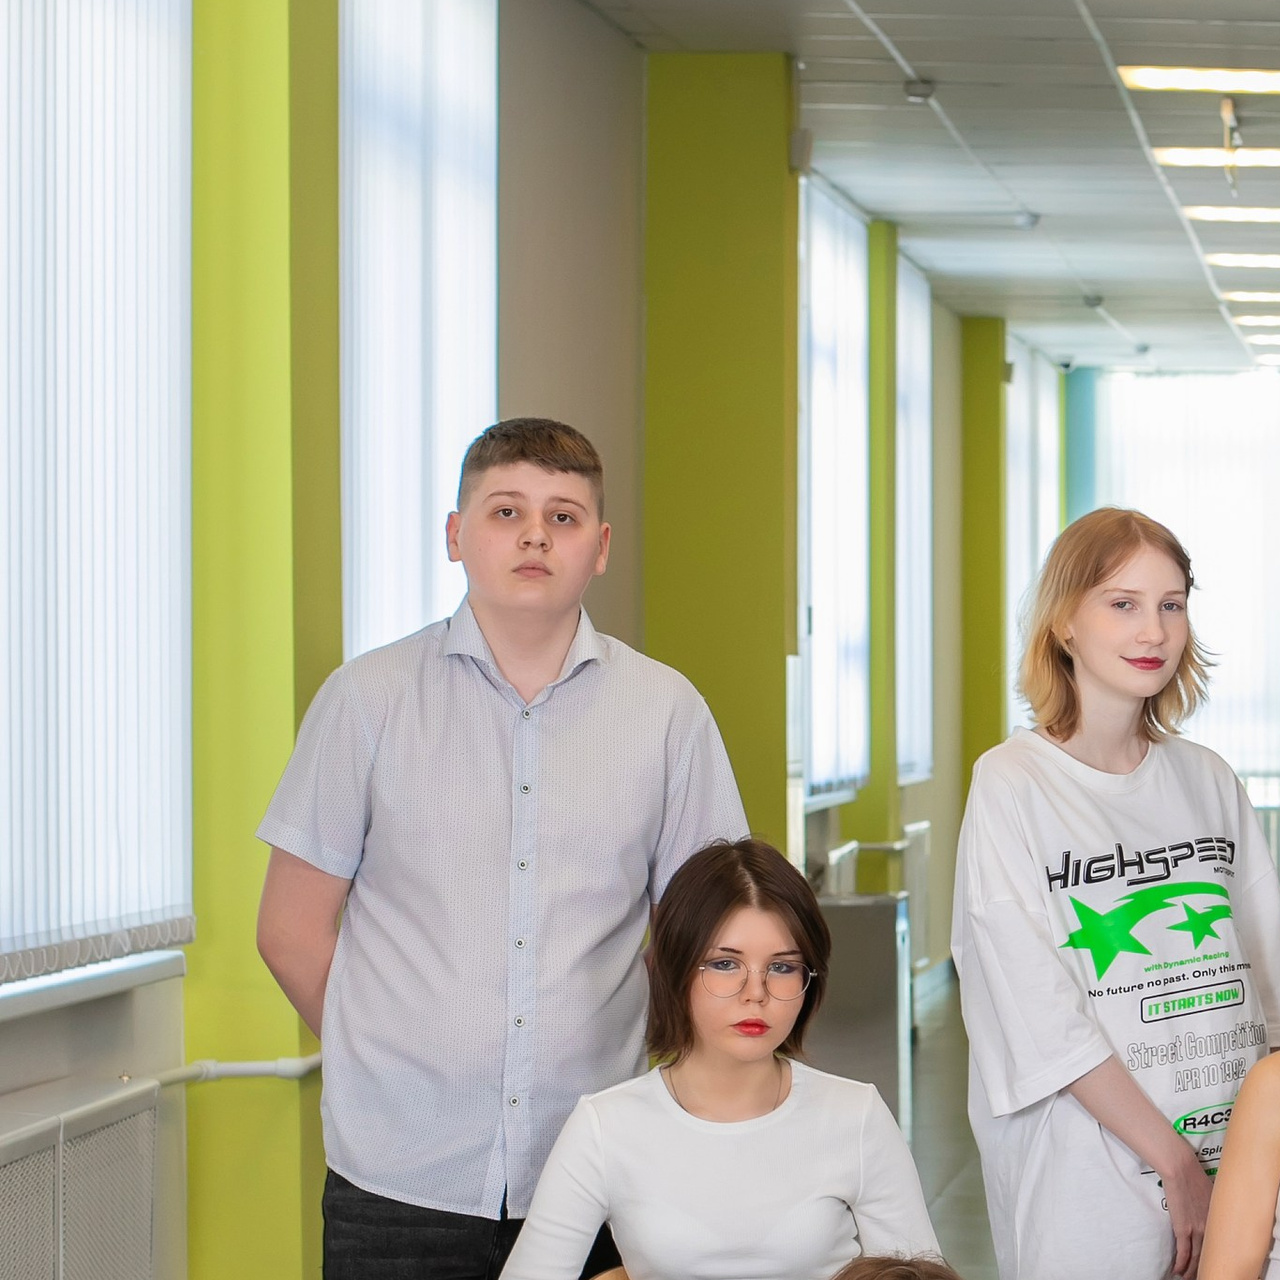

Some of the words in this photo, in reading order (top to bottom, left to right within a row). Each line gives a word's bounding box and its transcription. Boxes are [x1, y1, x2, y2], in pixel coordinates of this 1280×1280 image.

[1144, 962, 1163, 973] with
[1163, 956, 1201, 969] Dynamic
[1202, 951, 1230, 962] Racing
[1088, 989, 1104, 998] No
[1106, 983, 1144, 996] future
[1147, 979, 1162, 988] no
[1163, 973, 1190, 986] past.
[1192, 967, 1217, 977] Only
[1219, 963, 1236, 974] this
[1148, 1003, 1162, 1016] IT
[1164, 993, 1213, 1013] STARTS
[1215, 988, 1240, 1003] NOW
[1127, 1035, 1184, 1071] Street
[1184, 1021, 1266, 1060] Competition
[1175, 1068, 1202, 1093] APR
[1203, 1064, 1219, 1087] 10
[1219, 1057, 1247, 1083] 1992
